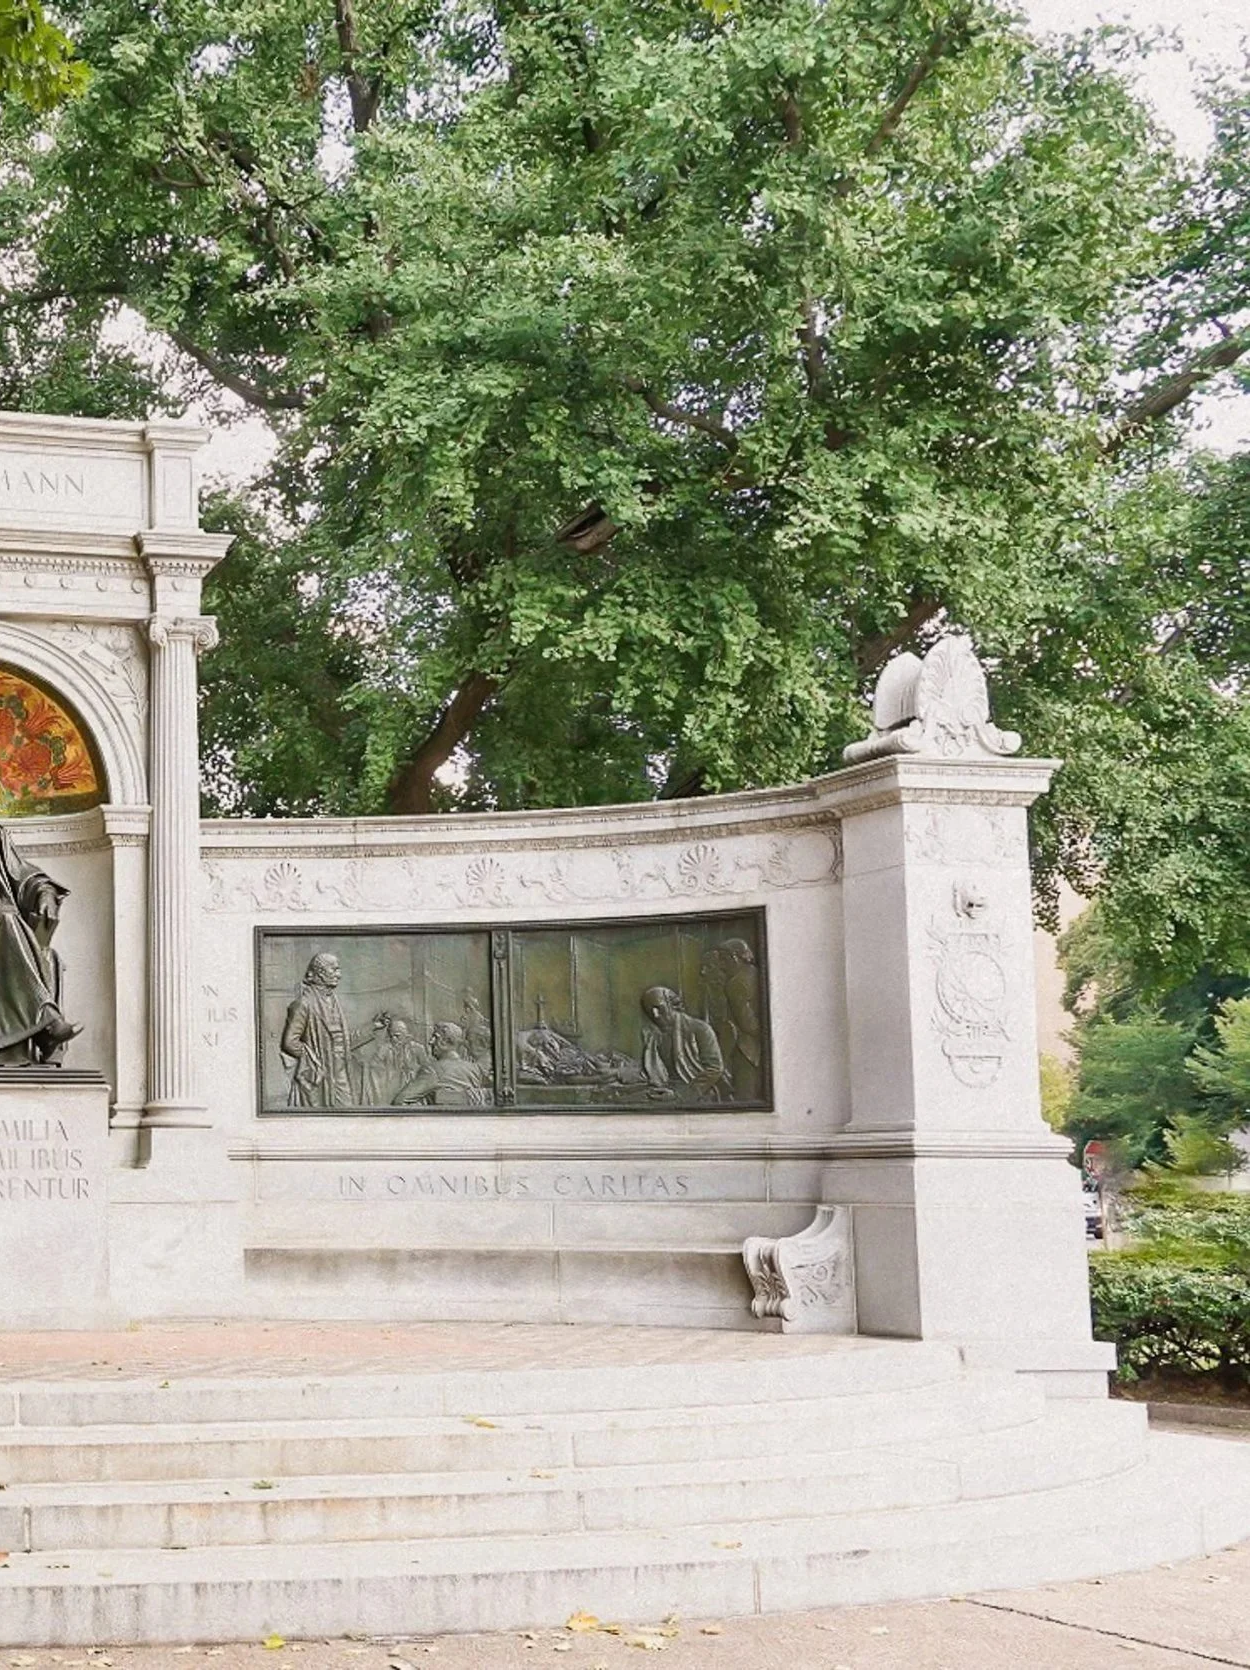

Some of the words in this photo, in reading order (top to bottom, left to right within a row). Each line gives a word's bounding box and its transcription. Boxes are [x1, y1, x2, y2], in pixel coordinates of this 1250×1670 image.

[338, 1174, 365, 1196] IN
[386, 1174, 529, 1196] OMNIBUS
[553, 1174, 691, 1196] CARITAS
